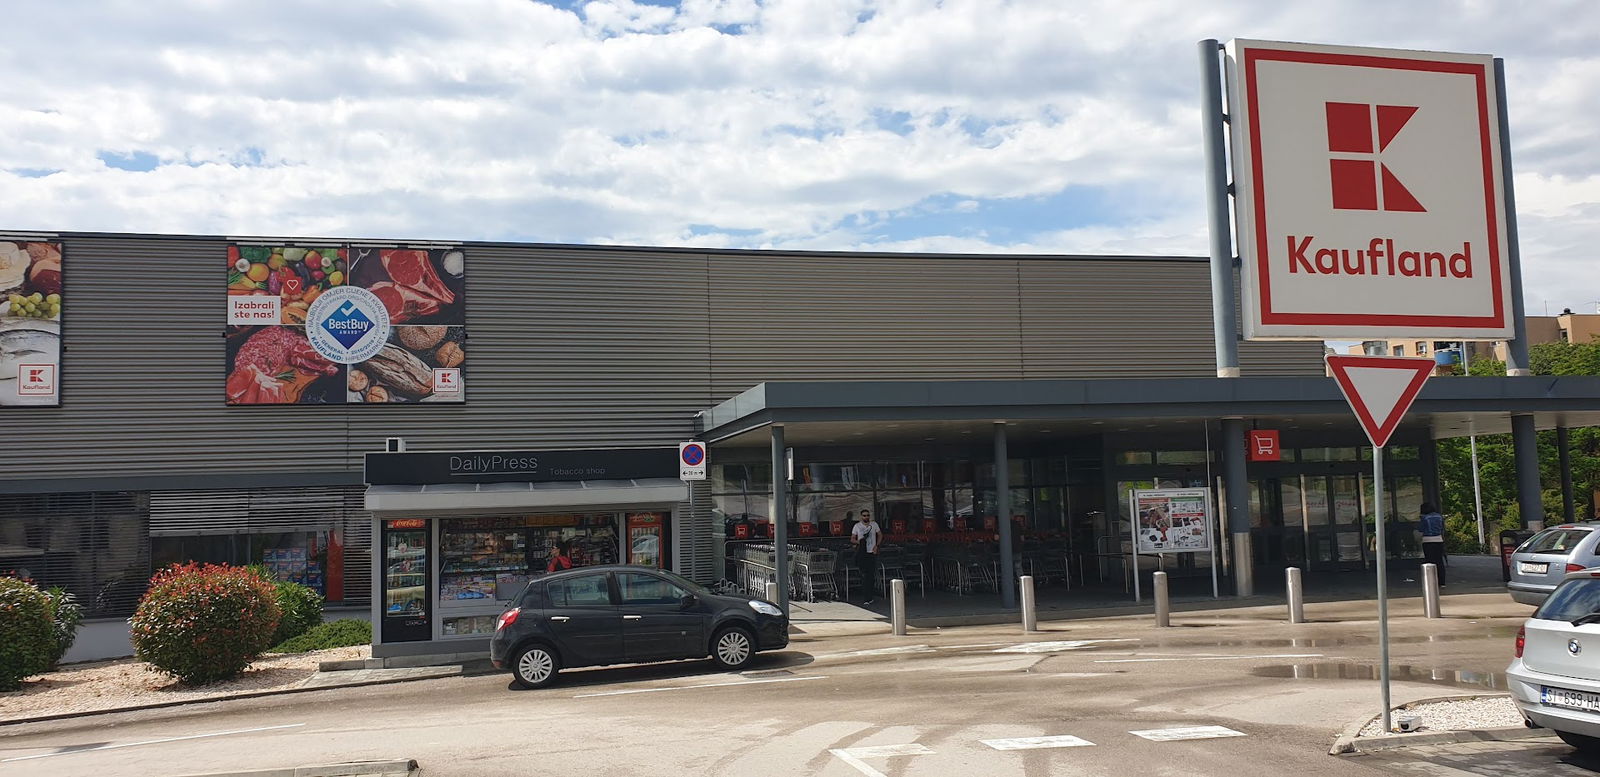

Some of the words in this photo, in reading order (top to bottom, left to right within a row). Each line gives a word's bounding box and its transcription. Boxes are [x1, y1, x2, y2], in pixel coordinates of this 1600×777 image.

[1286, 235, 1473, 279] Kaufland
[324, 288, 344, 300] OMJER
[234, 300, 274, 309] Izabrali
[234, 310, 250, 318] ste
[253, 310, 275, 318] nas!
[329, 319, 369, 332] BestBuy
[321, 339, 344, 354] GENERAL
[345, 336, 384, 361] HIPERMARKET
[450, 455, 538, 472] DailyPress
[550, 467, 584, 475] Tobacco
[586, 467, 605, 475] shop
